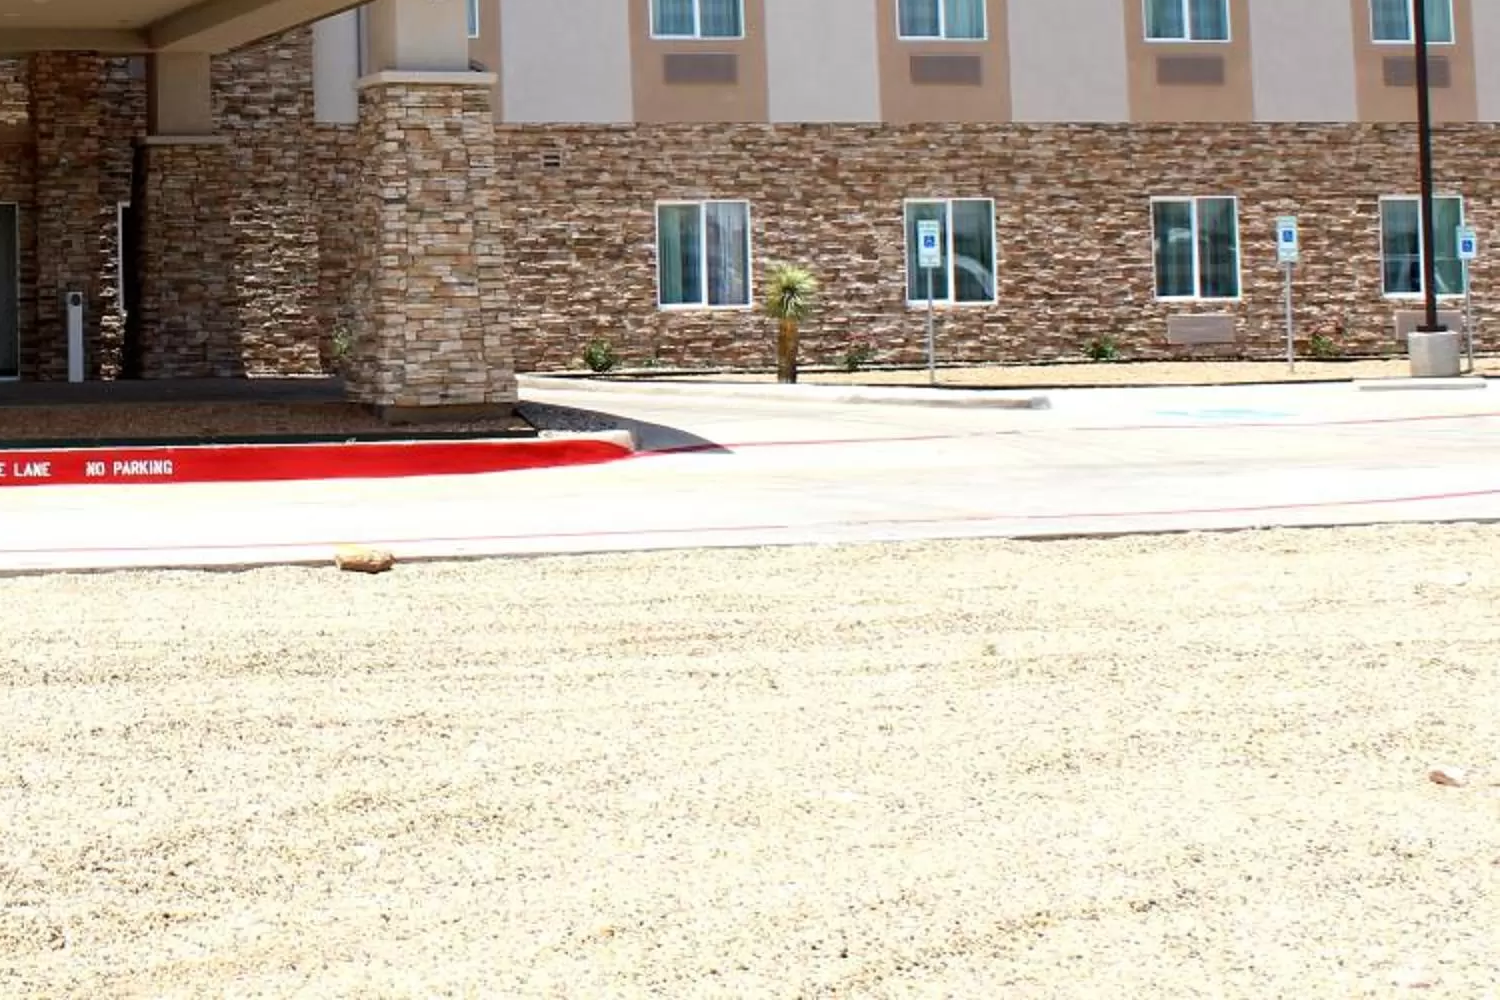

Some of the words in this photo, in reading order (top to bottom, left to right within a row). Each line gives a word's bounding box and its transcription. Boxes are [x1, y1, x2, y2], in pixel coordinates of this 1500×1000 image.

[13, 461, 51, 477] LANE
[86, 460, 105, 476] NO
[113, 460, 173, 475] PARKING
